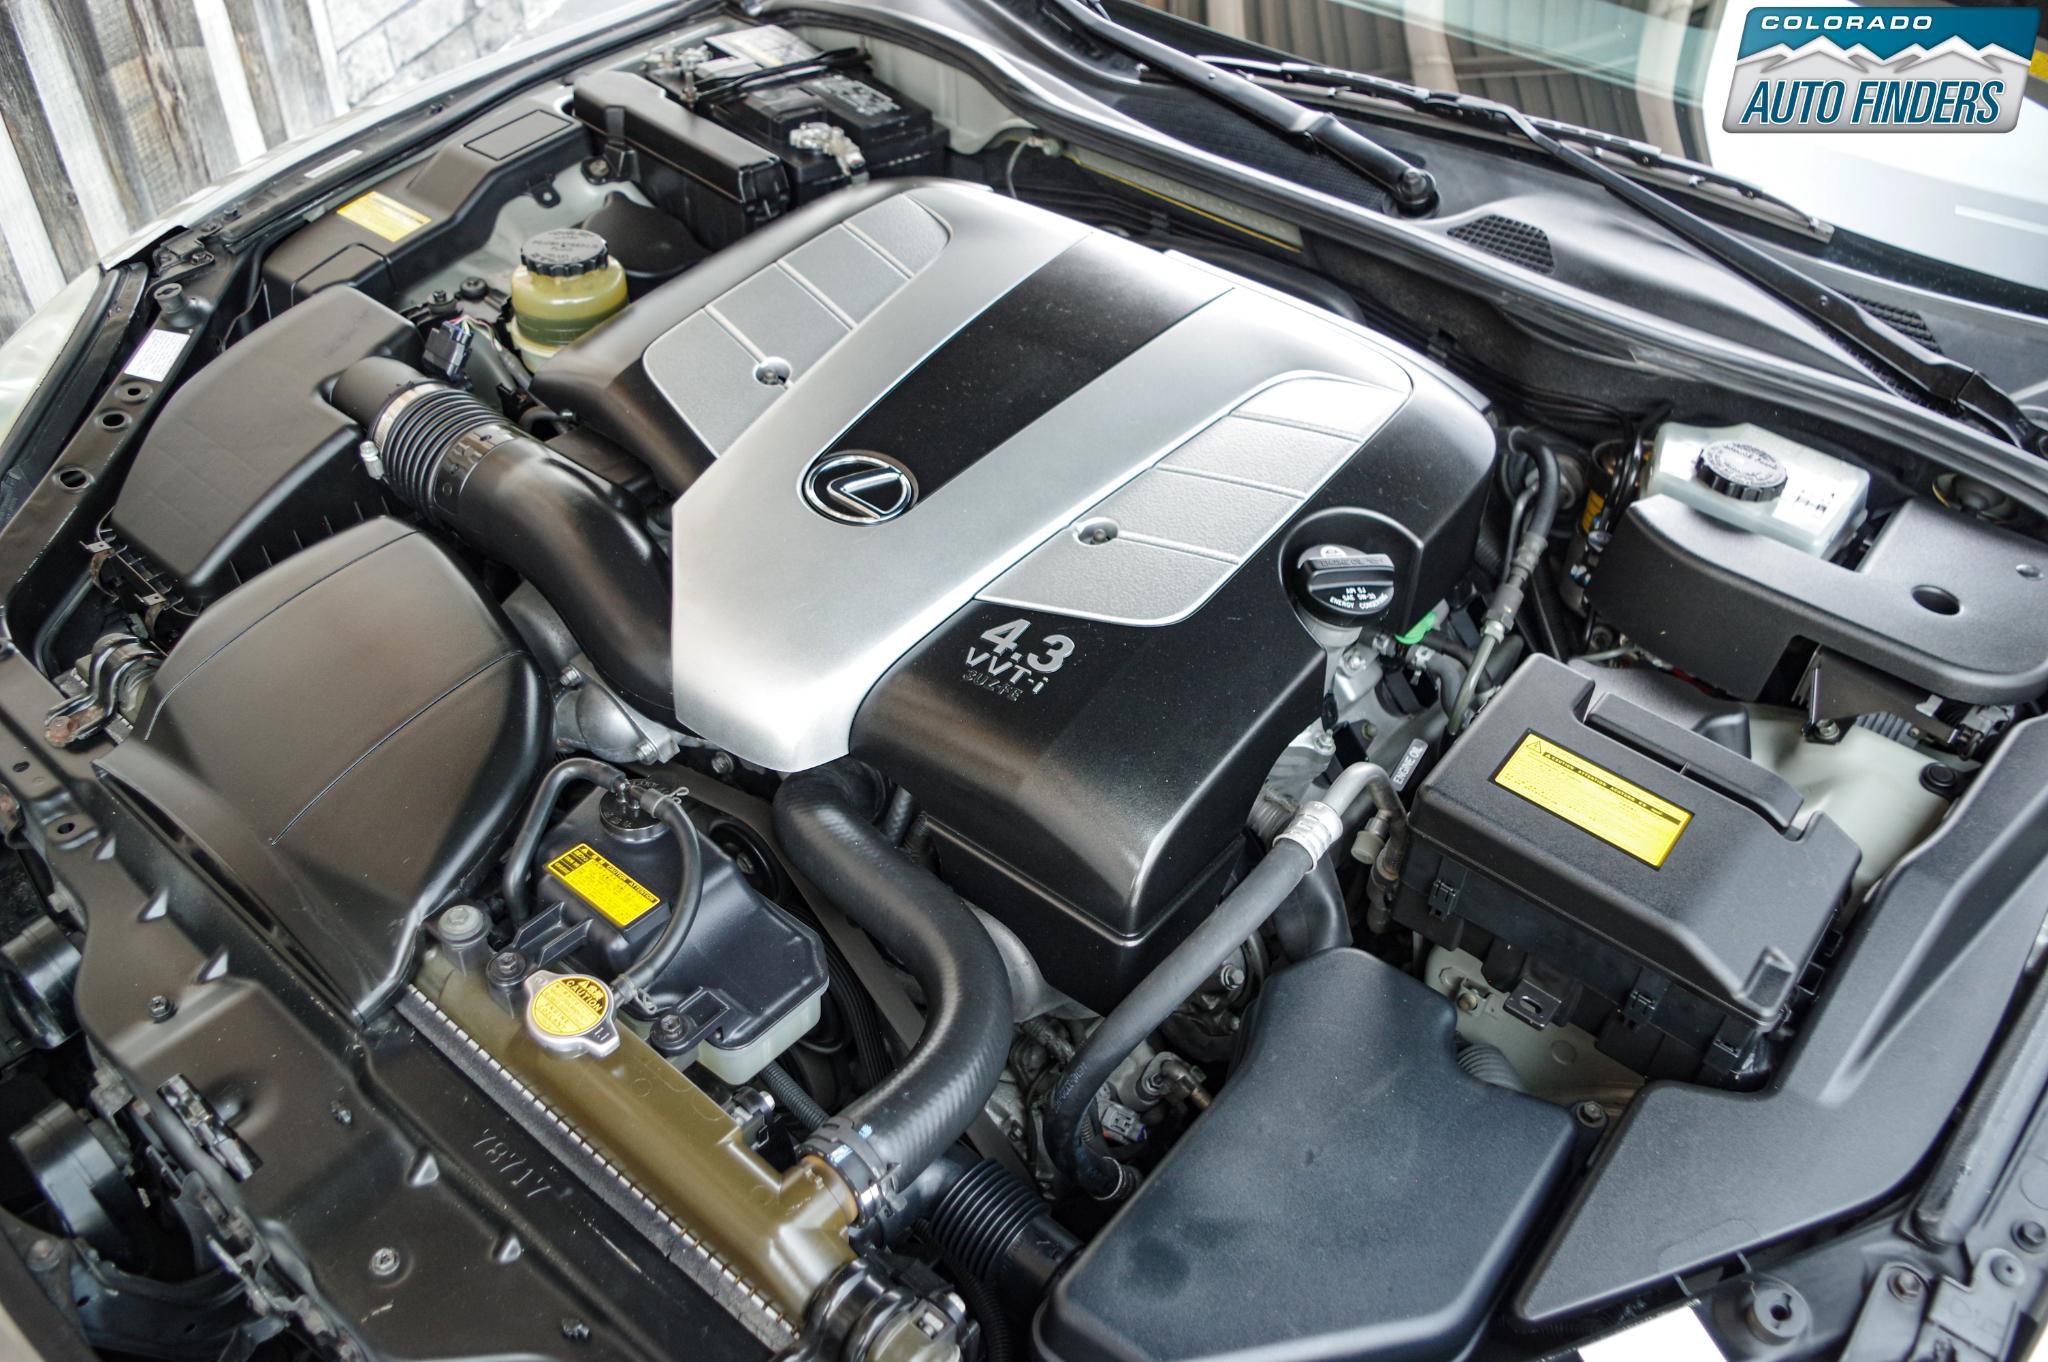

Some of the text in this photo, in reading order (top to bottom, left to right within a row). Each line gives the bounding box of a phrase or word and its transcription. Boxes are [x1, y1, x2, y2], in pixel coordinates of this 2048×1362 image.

[1329, 596, 1355, 609] ENERGY
[980, 618, 1076, 674] 4.3
[965, 646, 1049, 695] VVT-i
[1393, 746, 1423, 785] ENGINE OIL
[566, 980, 604, 1012] CAUTION
[473, 1128, 552, 1198] 78717
